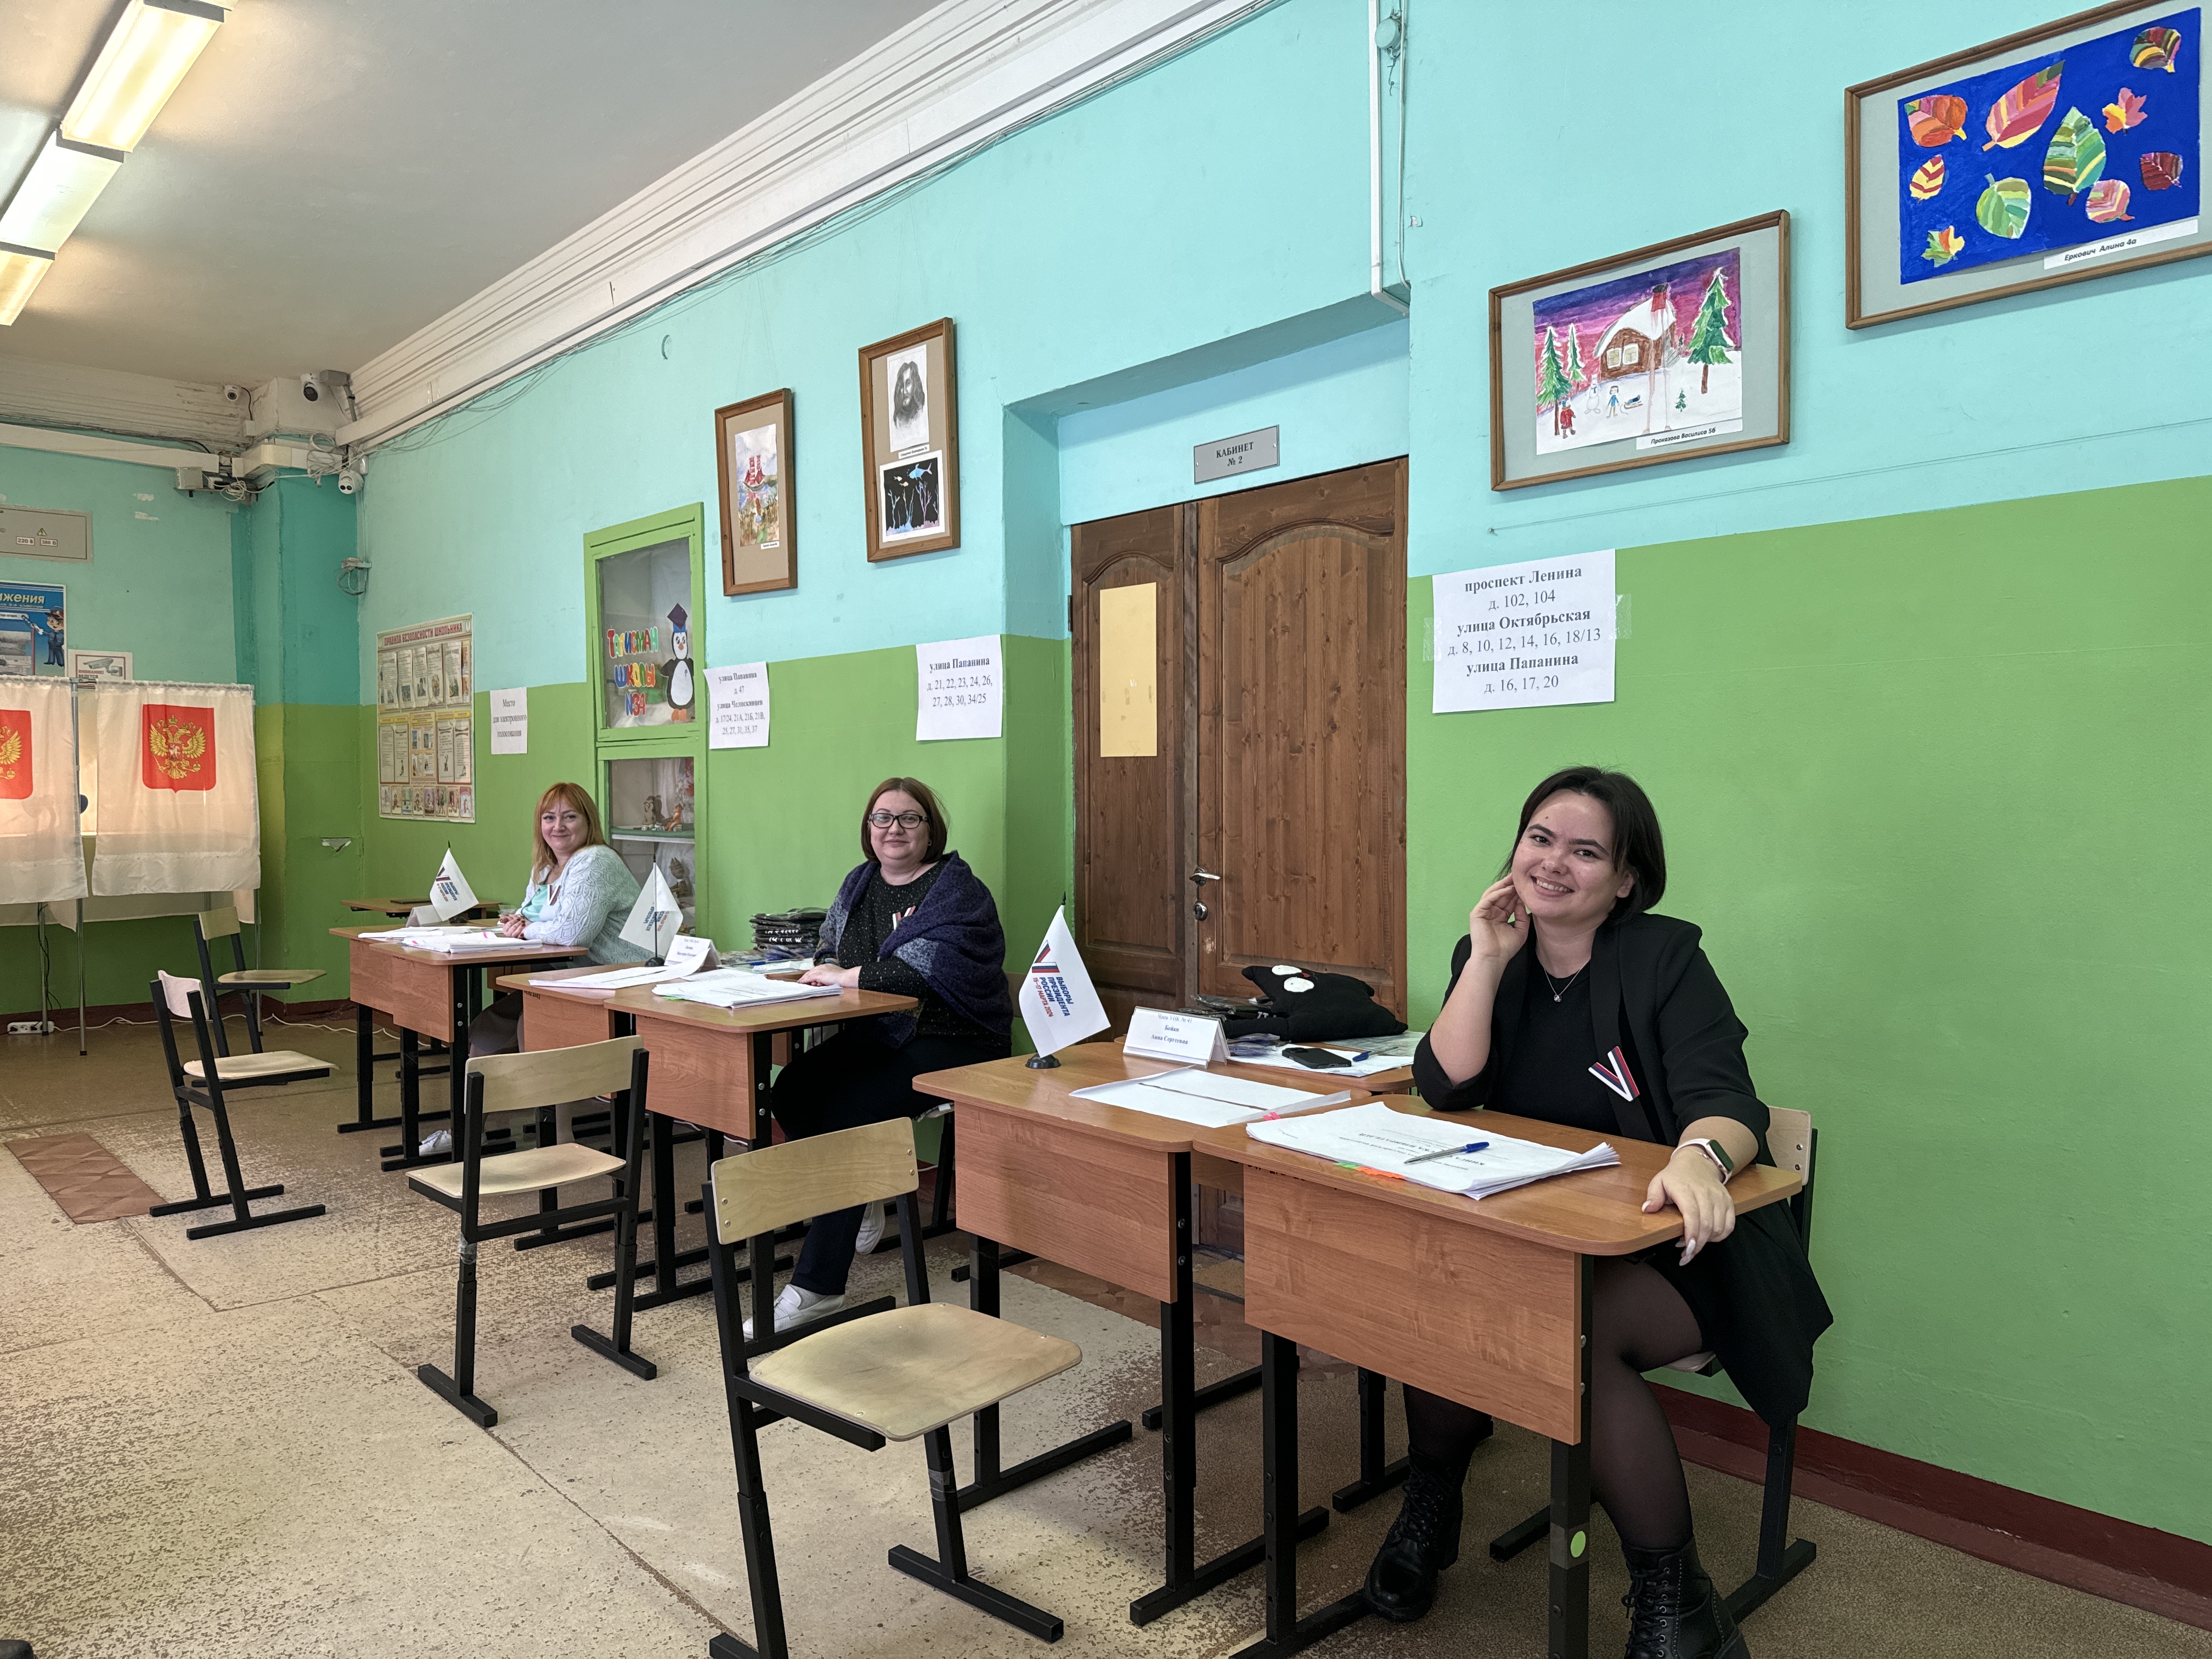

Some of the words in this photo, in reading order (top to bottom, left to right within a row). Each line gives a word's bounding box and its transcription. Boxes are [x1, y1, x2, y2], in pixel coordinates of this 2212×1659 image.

[2064, 249, 2096, 261] Еркович
[2099, 241, 2125, 252] Алина
[1651, 436, 1680, 445] Проказова
[1681, 430, 1707, 439] Василиса
[1216, 442, 1254, 458] КАБИНЕТ
[1227, 458, 1236, 466] №
[1238, 456, 1243, 464] 2
[1465, 574, 1526, 594] проспект
[1529, 568, 1582, 584] Ленина
[1488, 600, 1499, 611] д.
[1504, 594, 1529, 608] 102,
[1534, 589, 1556, 604] 104
[1457, 620, 1496, 637] улица
[1499, 610, 1591, 629] Октябрьская
[384, 634, 402, 646] ПРАВИЛА
[402, 628, 433, 643] БЕЗОПАСНОСТИ
[435, 623, 463, 637] ШКОЛЬНИКА
[1447, 646, 1458, 656] д.
[1462, 641, 1472, 655] 8,
[1477, 640, 1494, 653] 10,
[1499, 637, 1516, 651] 12,
[1521, 635, 1538, 649] 14,
[1543, 632, 1561, 647] 16,
[1566, 628, 1601, 644] 18/13
[929, 662, 950, 673] улица
[952, 658, 990, 669] Папанина
[1466, 660, 1505, 676] улица
[1510, 654, 1579, 670] Папанина
[719, 675, 733, 684] улица
[935, 680, 945, 691] 21,
[946, 679, 956, 690] 22,
[958, 678, 968, 689] 23,
[970, 676, 980, 687] 24,
[982, 675, 992, 686] 26,
[1484, 683, 1495, 693] д.
[1501, 679, 1517, 692] 16,
[1522, 677, 1539, 691] 17,
[1543, 675, 1559, 688] 20
[503, 699, 516, 708] Место
[717, 703, 731, 711] улица
[933, 697, 942, 708] 27,
[944, 696, 954, 707] 28,
[956, 695, 966, 706] 30,
[968, 693, 986, 704] 34/25
[500, 714, 527, 724] электронного
[744, 713, 754, 721] 21Б,
[755, 712, 765, 720] 21В,
[1039, 977, 1056, 1002] РОССИИ
[1047, 977, 1071, 1017] ПРЕЗИДЕНТА
[1056, 977, 1074, 1005] ВЫБОРЫ
[1037, 990, 1049, 1006] МАРТА
[1164, 1035, 1188, 1045] Сергеевна
